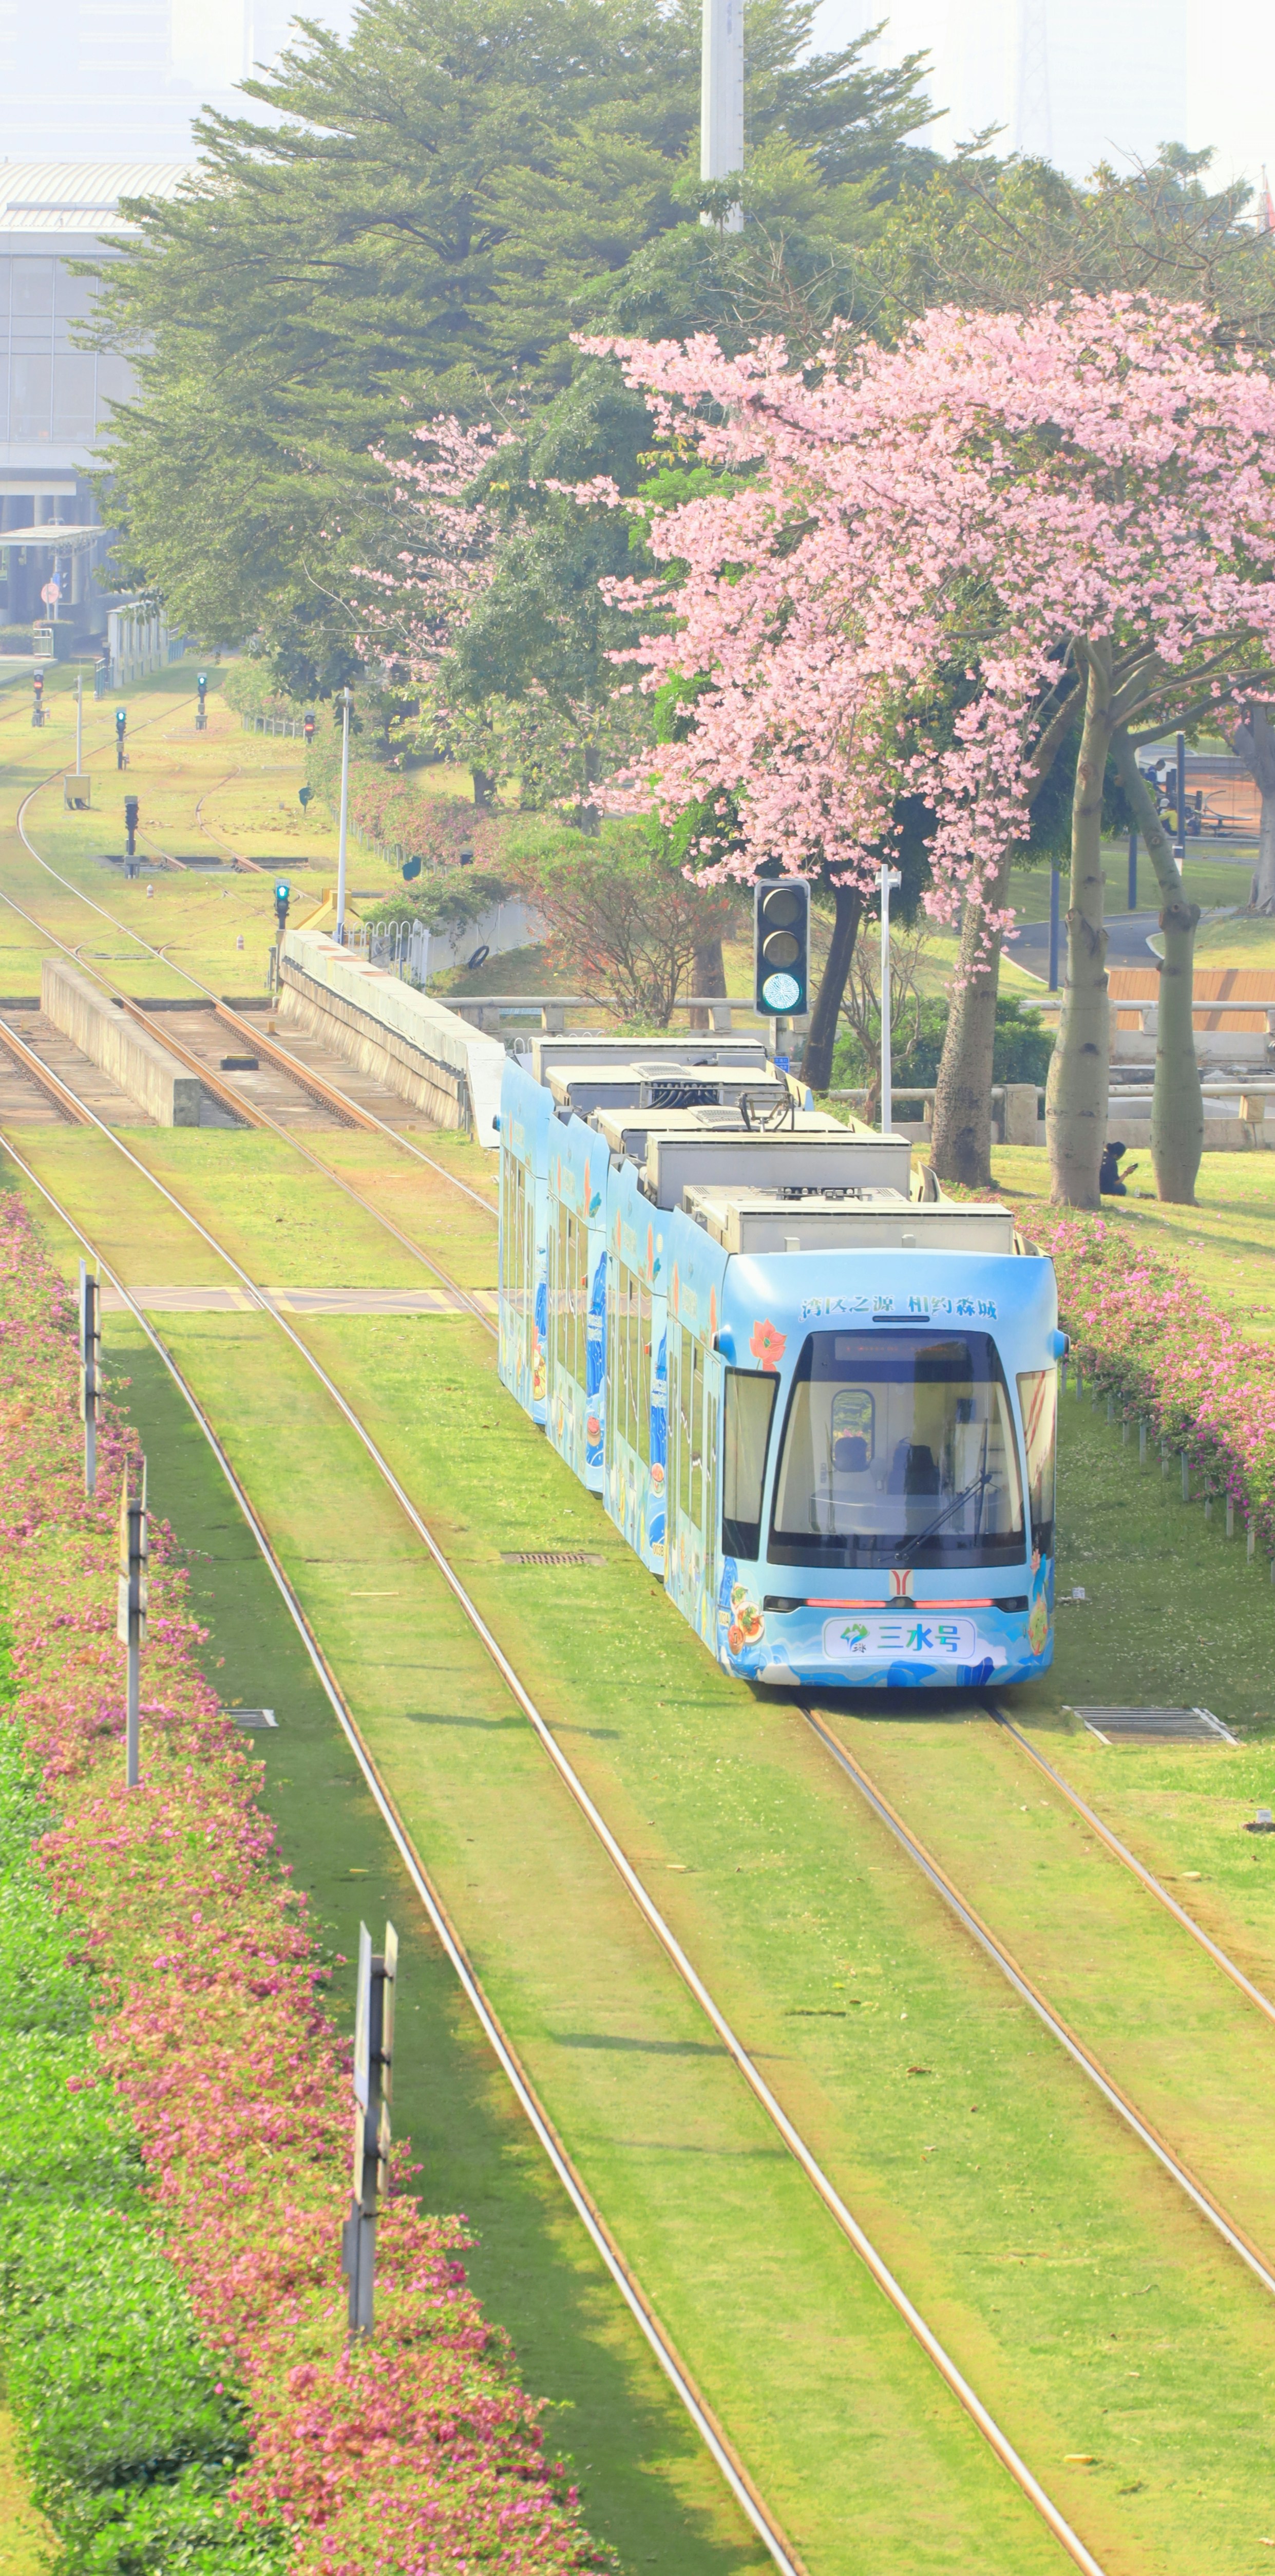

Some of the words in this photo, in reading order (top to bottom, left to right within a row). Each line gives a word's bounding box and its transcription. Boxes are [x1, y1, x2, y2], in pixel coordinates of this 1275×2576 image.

[800, 1295, 895, 1322] 湾区之源
[877, 1623, 961, 1652] 三水号
